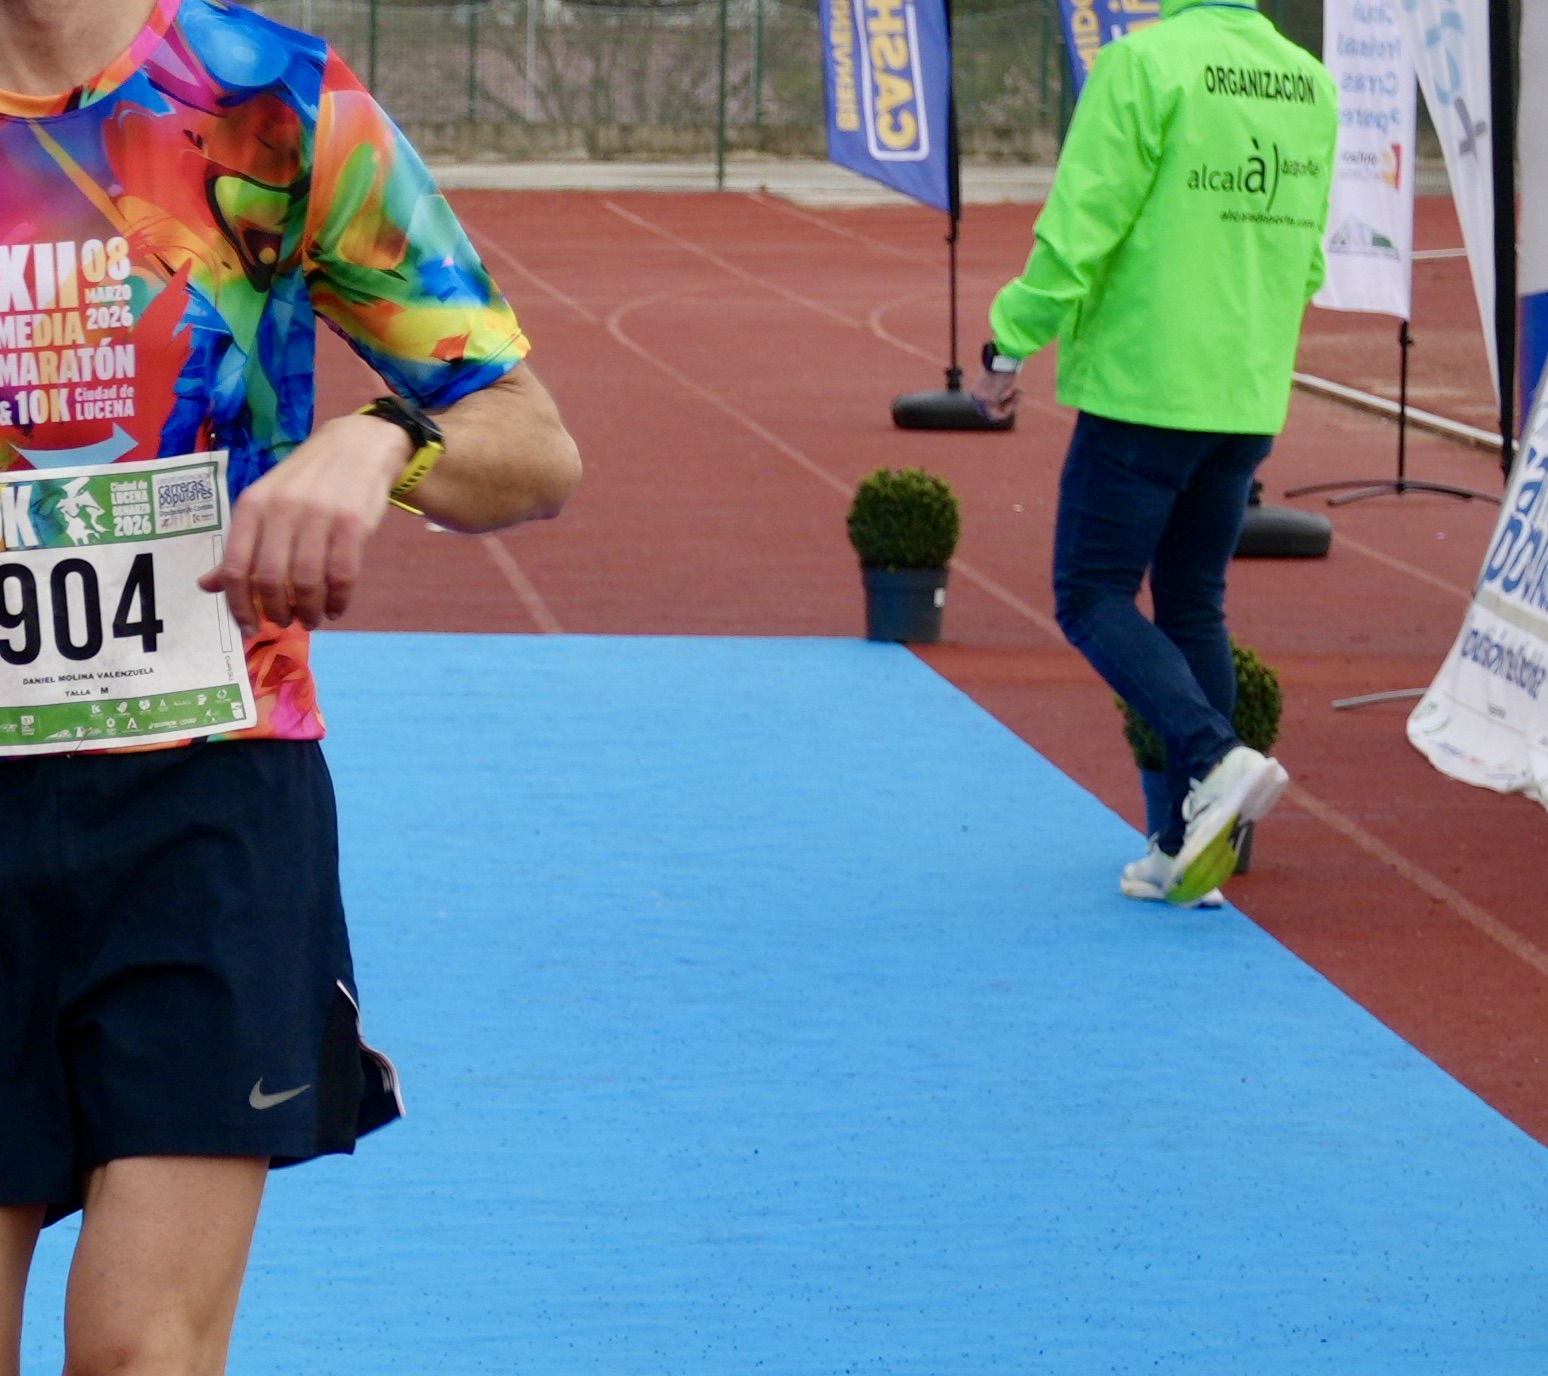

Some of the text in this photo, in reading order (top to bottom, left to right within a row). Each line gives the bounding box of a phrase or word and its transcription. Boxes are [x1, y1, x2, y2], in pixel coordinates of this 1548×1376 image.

[1204, 64, 1315, 105] ORGANIZACIÓN
[81, 236, 132, 283] 08
[84, 284, 133, 305] MARZO
[86, 304, 134, 330] 2026
[74, 384, 134, 402] Ciudad de
[15, 387, 71, 425] 10K
[75, 399, 135, 421] LUCENA
[158, 480, 204, 495] carreras
[159, 488, 213, 509] populares
[113, 515, 153, 537] 2026
[23, 667, 154, 685] DANIEL MOLINA VALENZUELA
[65, 687, 109, 697] TALLA M
